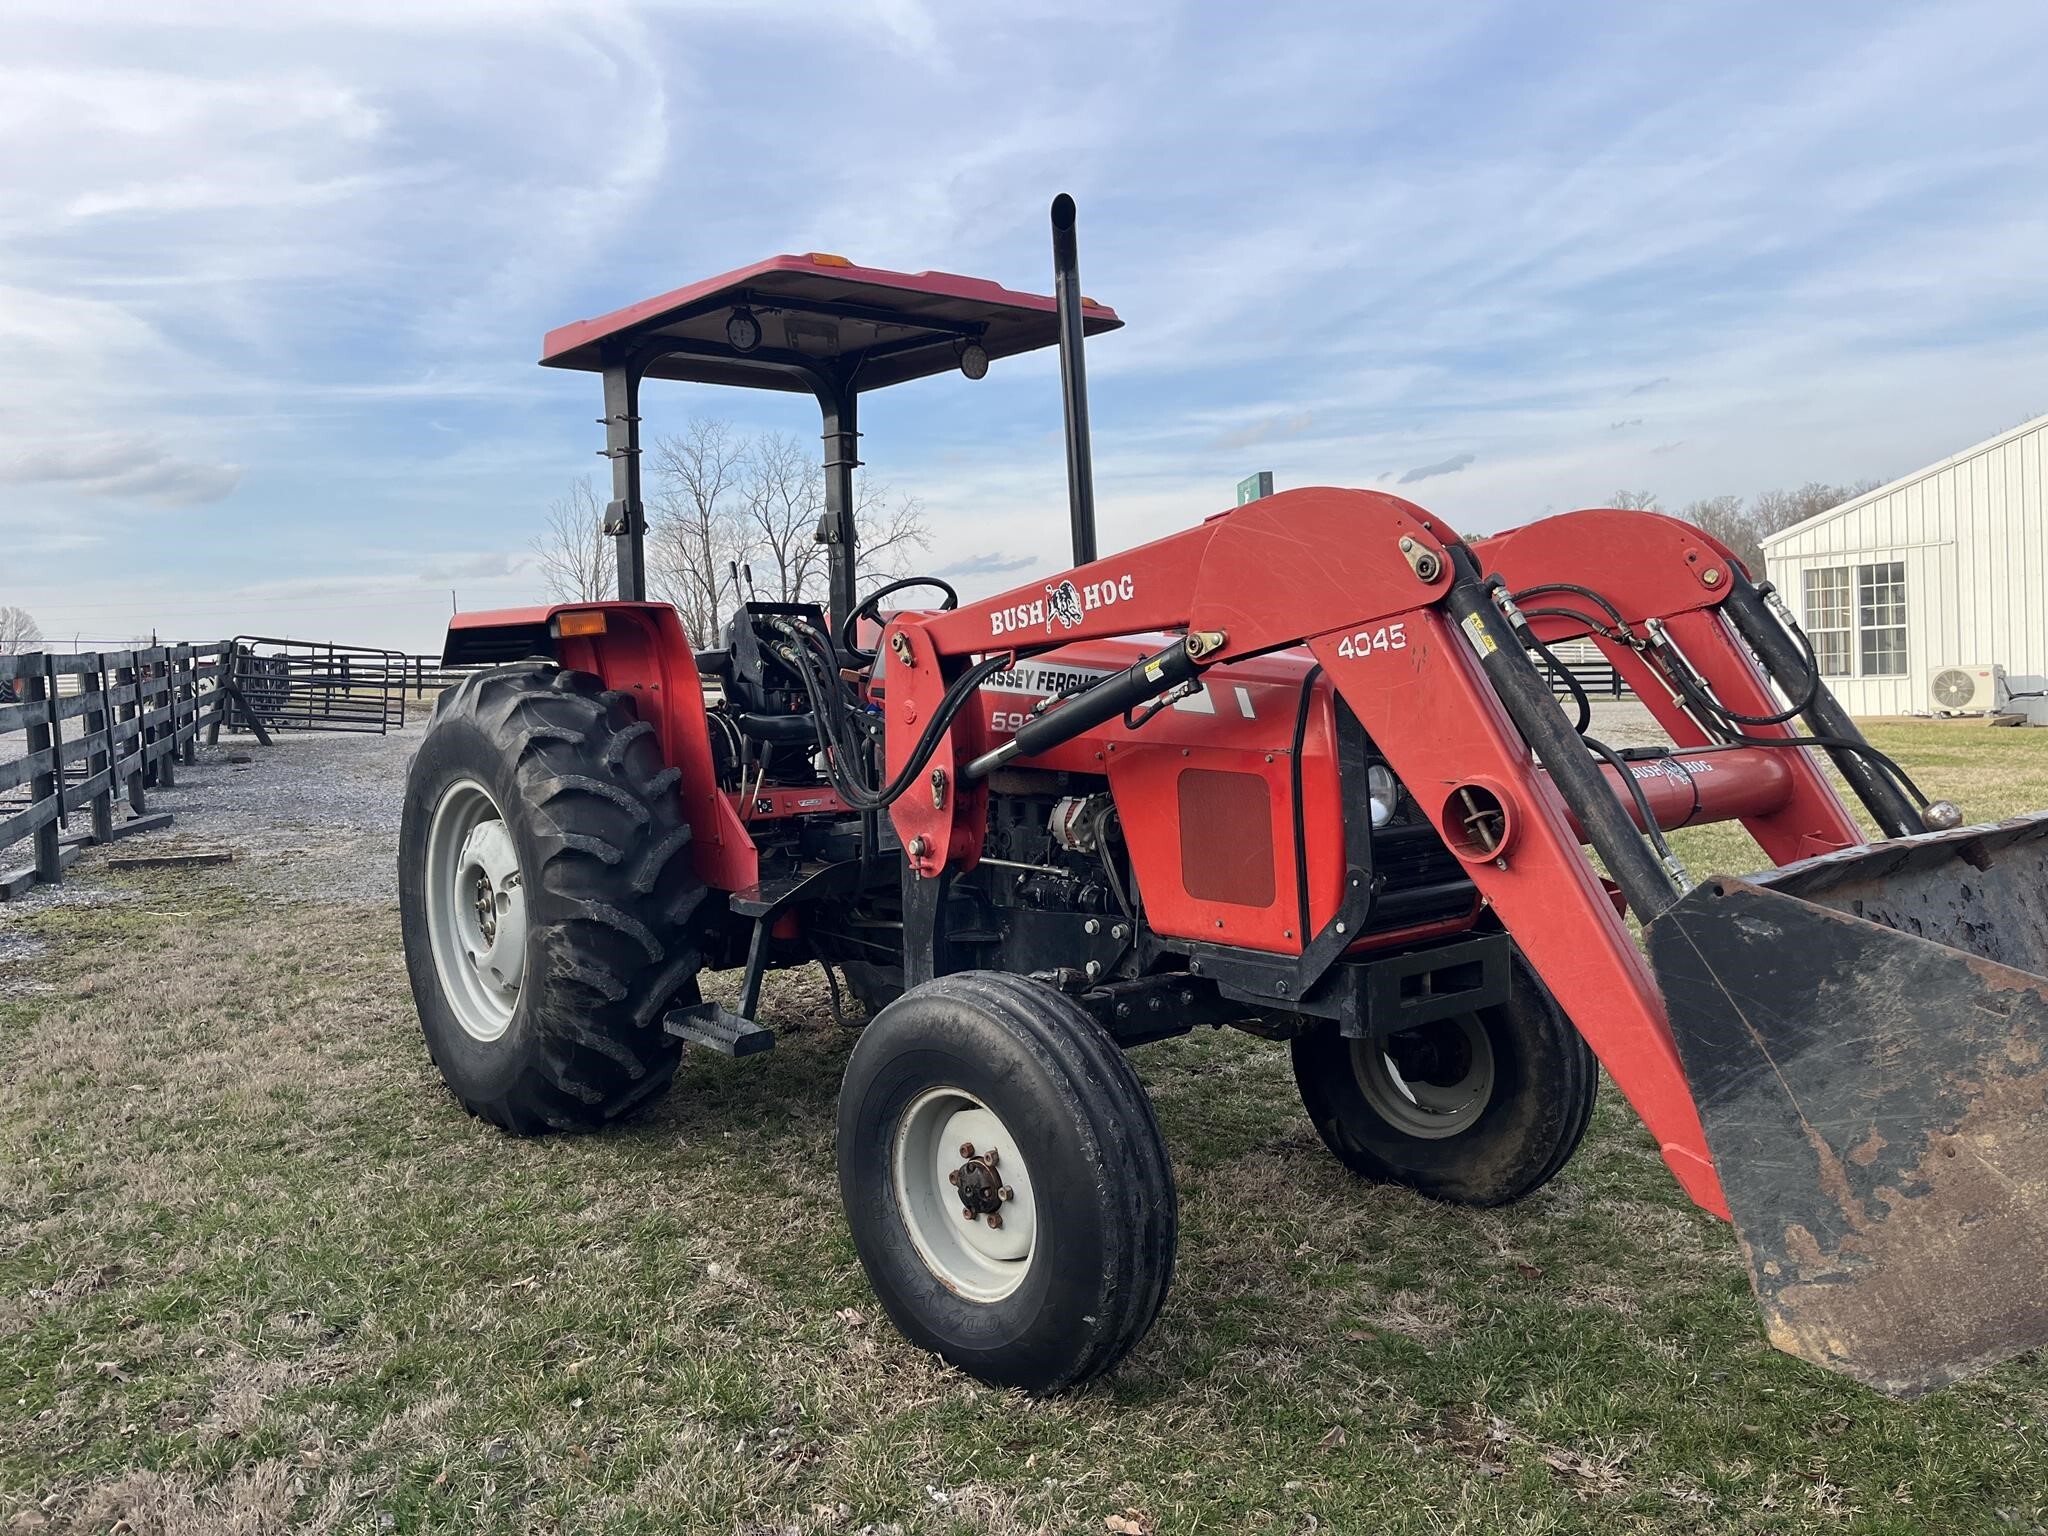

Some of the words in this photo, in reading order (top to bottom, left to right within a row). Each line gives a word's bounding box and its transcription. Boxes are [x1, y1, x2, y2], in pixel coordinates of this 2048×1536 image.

[990, 600, 1044, 635] BUSH
[1083, 574, 1134, 610] HOG
[1337, 623, 1407, 660] 4045
[1630, 765, 1664, 779] BUSH
[1680, 760, 1714, 774] HOG
